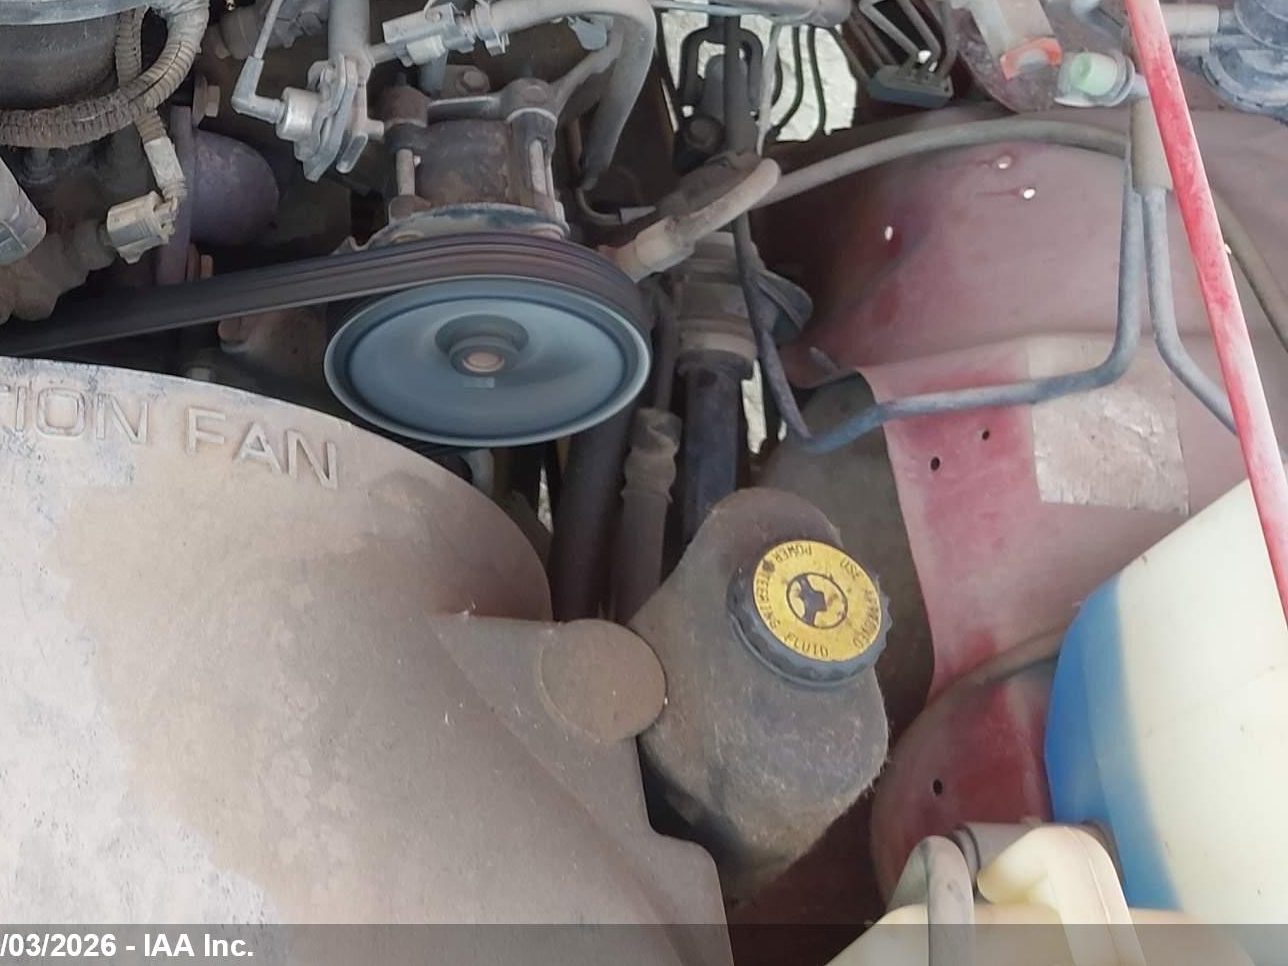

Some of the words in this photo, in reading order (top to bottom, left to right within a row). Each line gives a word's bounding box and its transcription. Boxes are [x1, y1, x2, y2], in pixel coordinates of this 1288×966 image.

[185, 405, 339, 491] FAN
[774, 542, 813, 563] POWER
[755, 559, 781, 631] TEERING
[783, 631, 830, 658] FLUID
